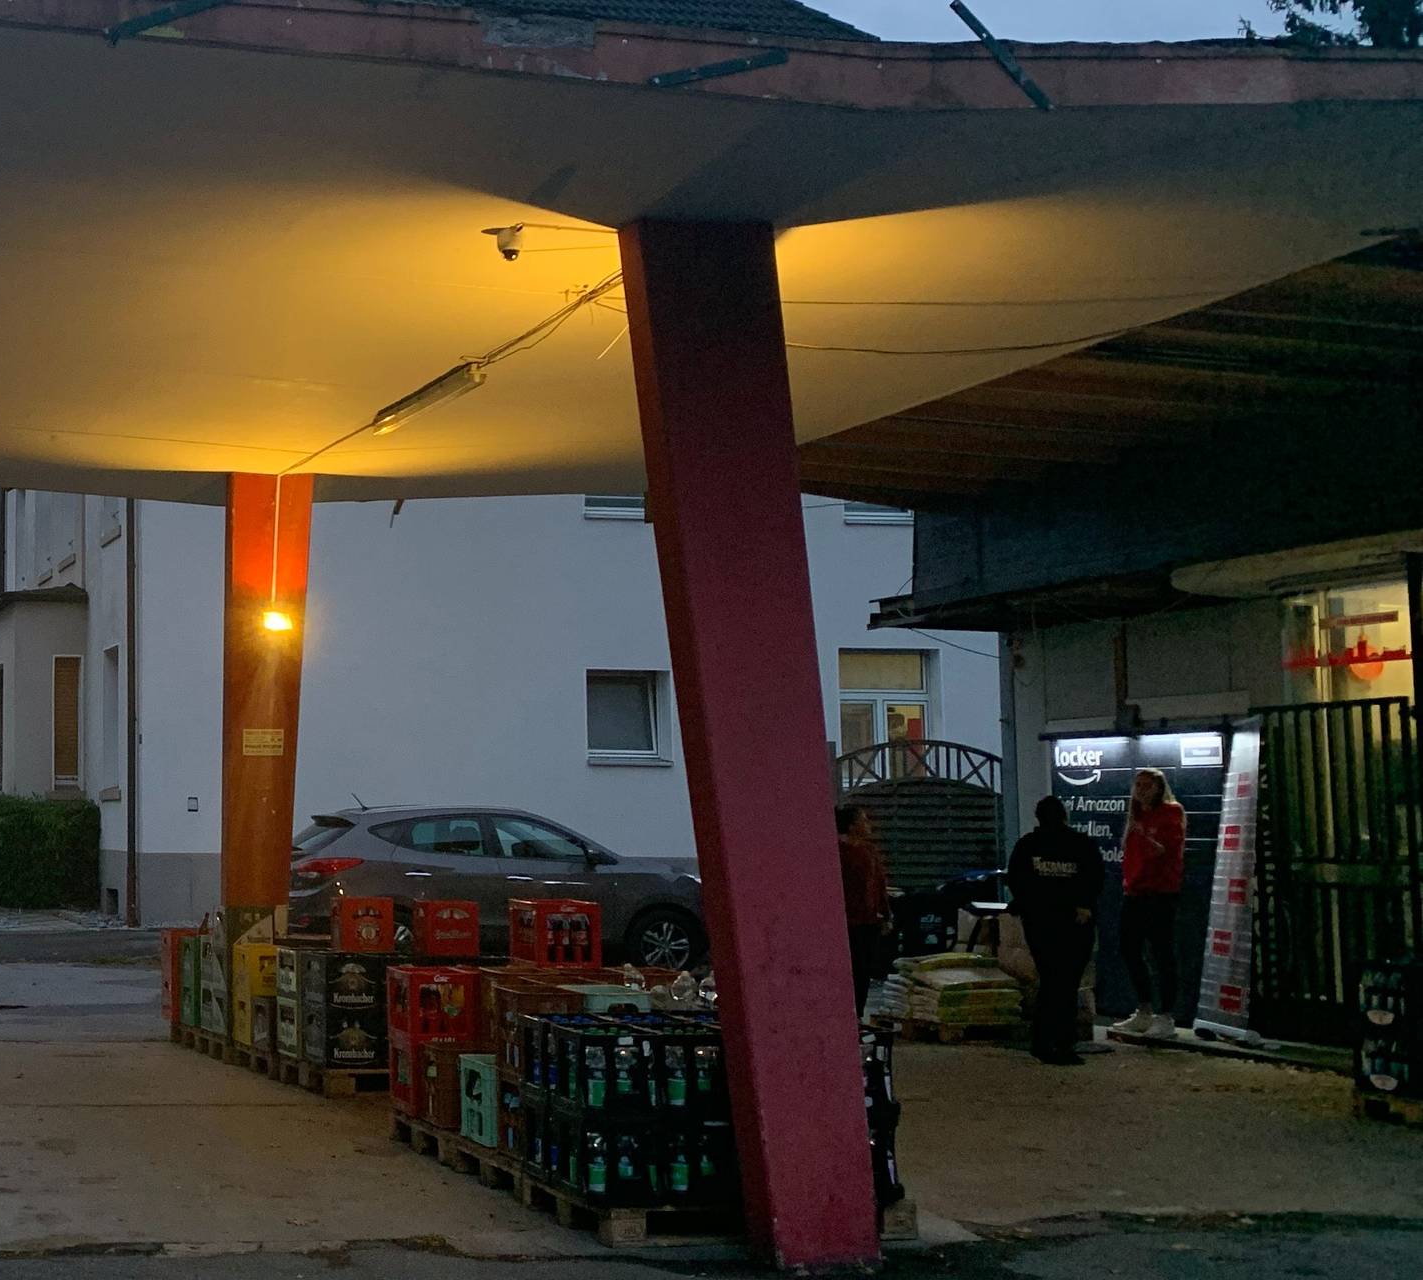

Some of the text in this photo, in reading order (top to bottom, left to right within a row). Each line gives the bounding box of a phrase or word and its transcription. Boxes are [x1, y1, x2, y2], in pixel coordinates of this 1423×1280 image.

[1054, 746, 1104, 768] locker
[1076, 796, 1126, 812] Amazon
[333, 992, 375, 1004] Krombacher
[334, 1047, 376, 1060] Krombacher
